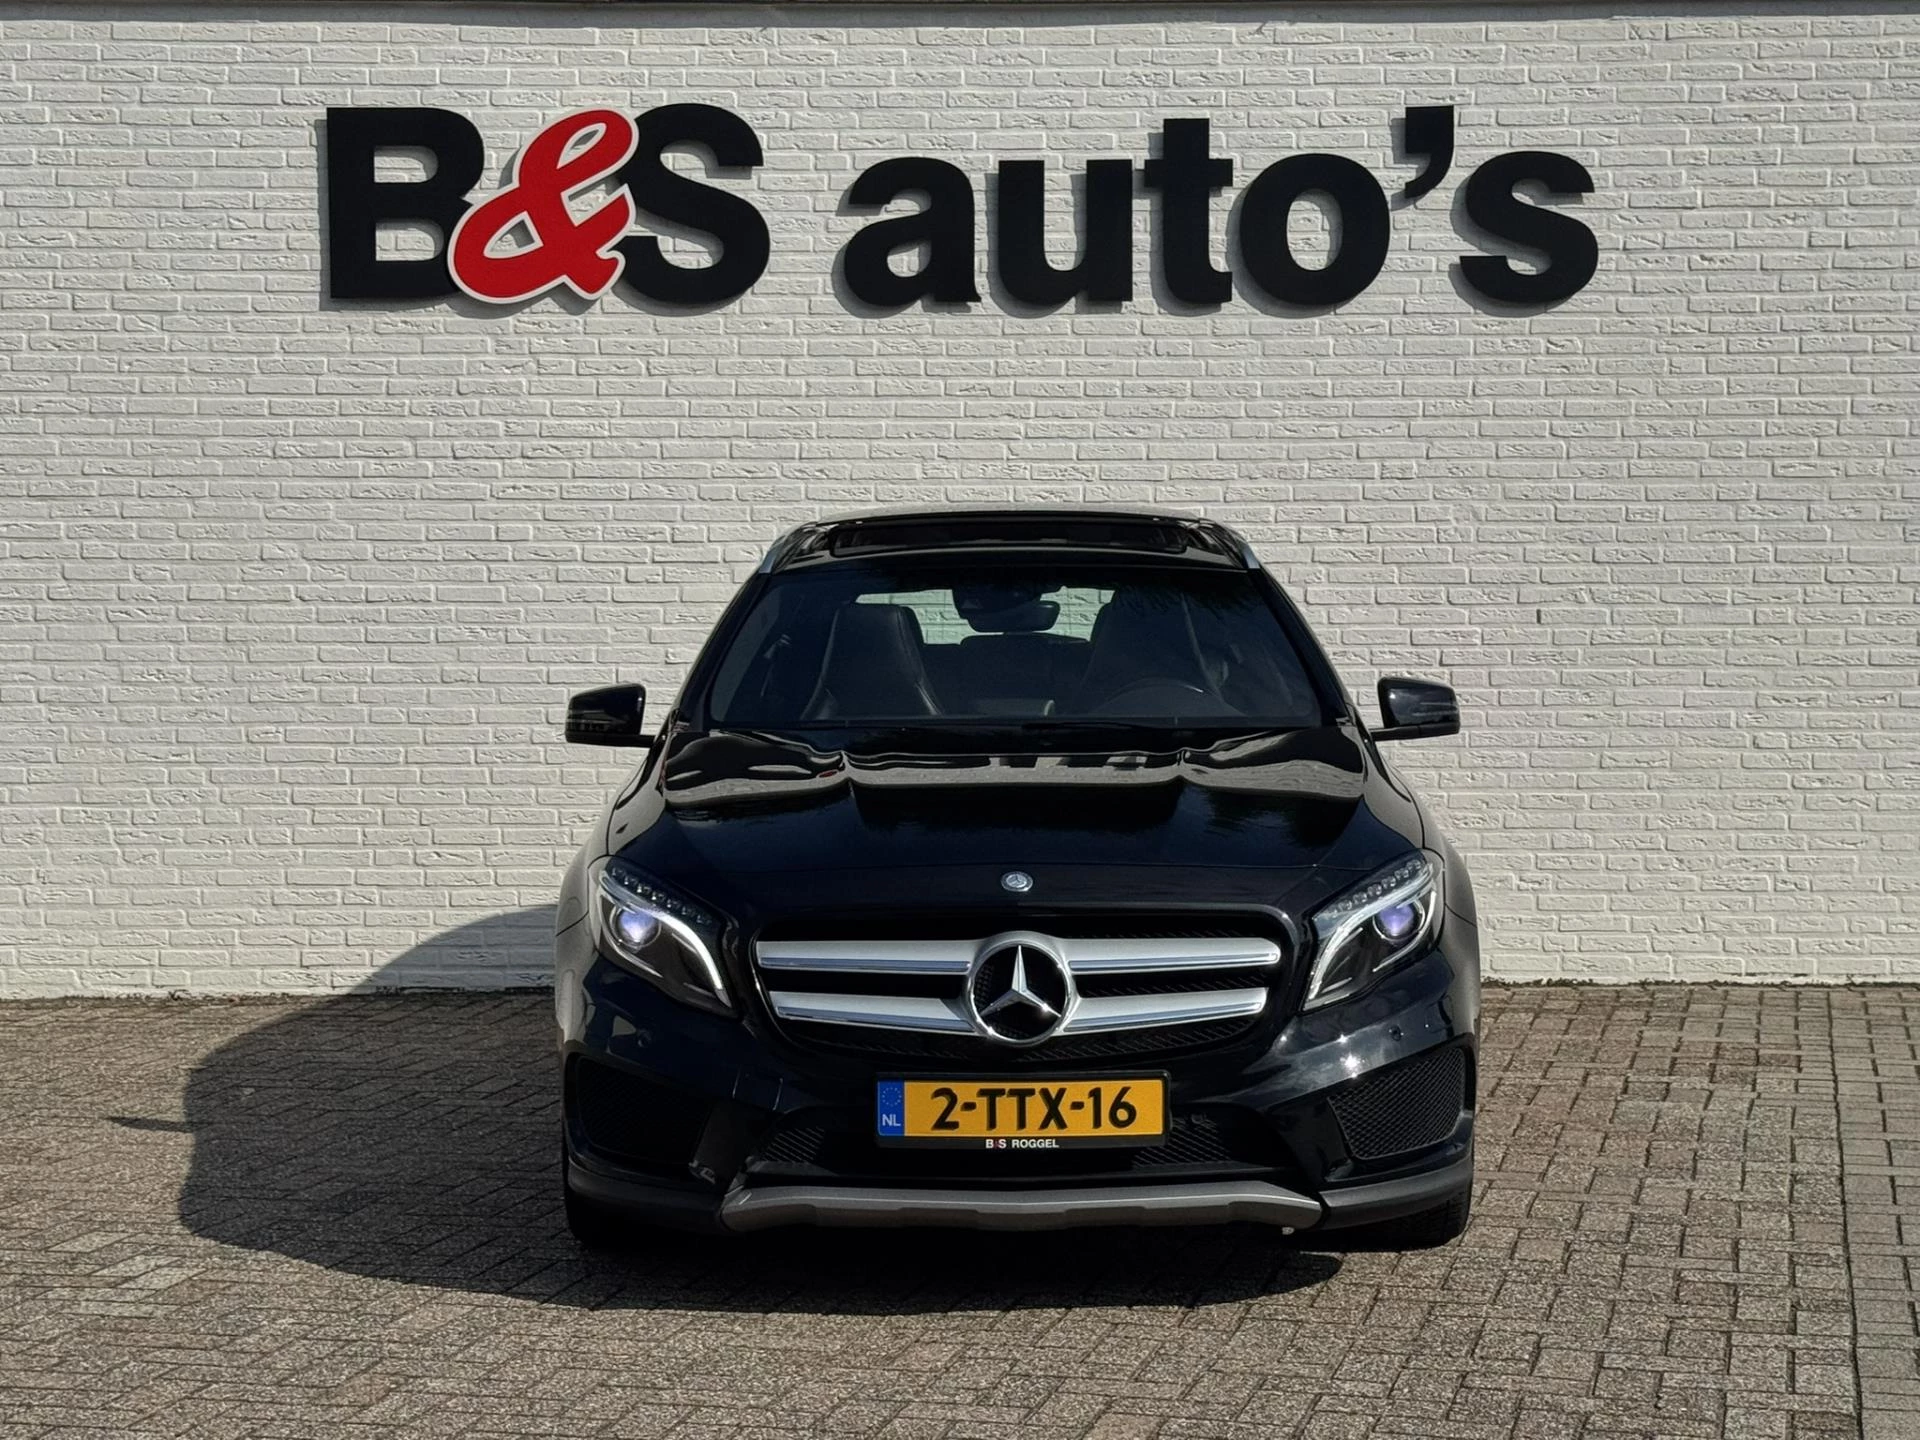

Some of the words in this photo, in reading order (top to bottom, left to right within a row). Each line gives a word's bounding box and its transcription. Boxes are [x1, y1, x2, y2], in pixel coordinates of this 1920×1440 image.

[326, 103, 770, 304] B&S
[843, 105, 1599, 307] auto's
[882, 1113, 901, 1127] NL
[930, 1086, 1138, 1131] 2-TTX-16
[985, 1138, 1007, 1149] BS
[1011, 1138, 1060, 1149] ROGGEL
